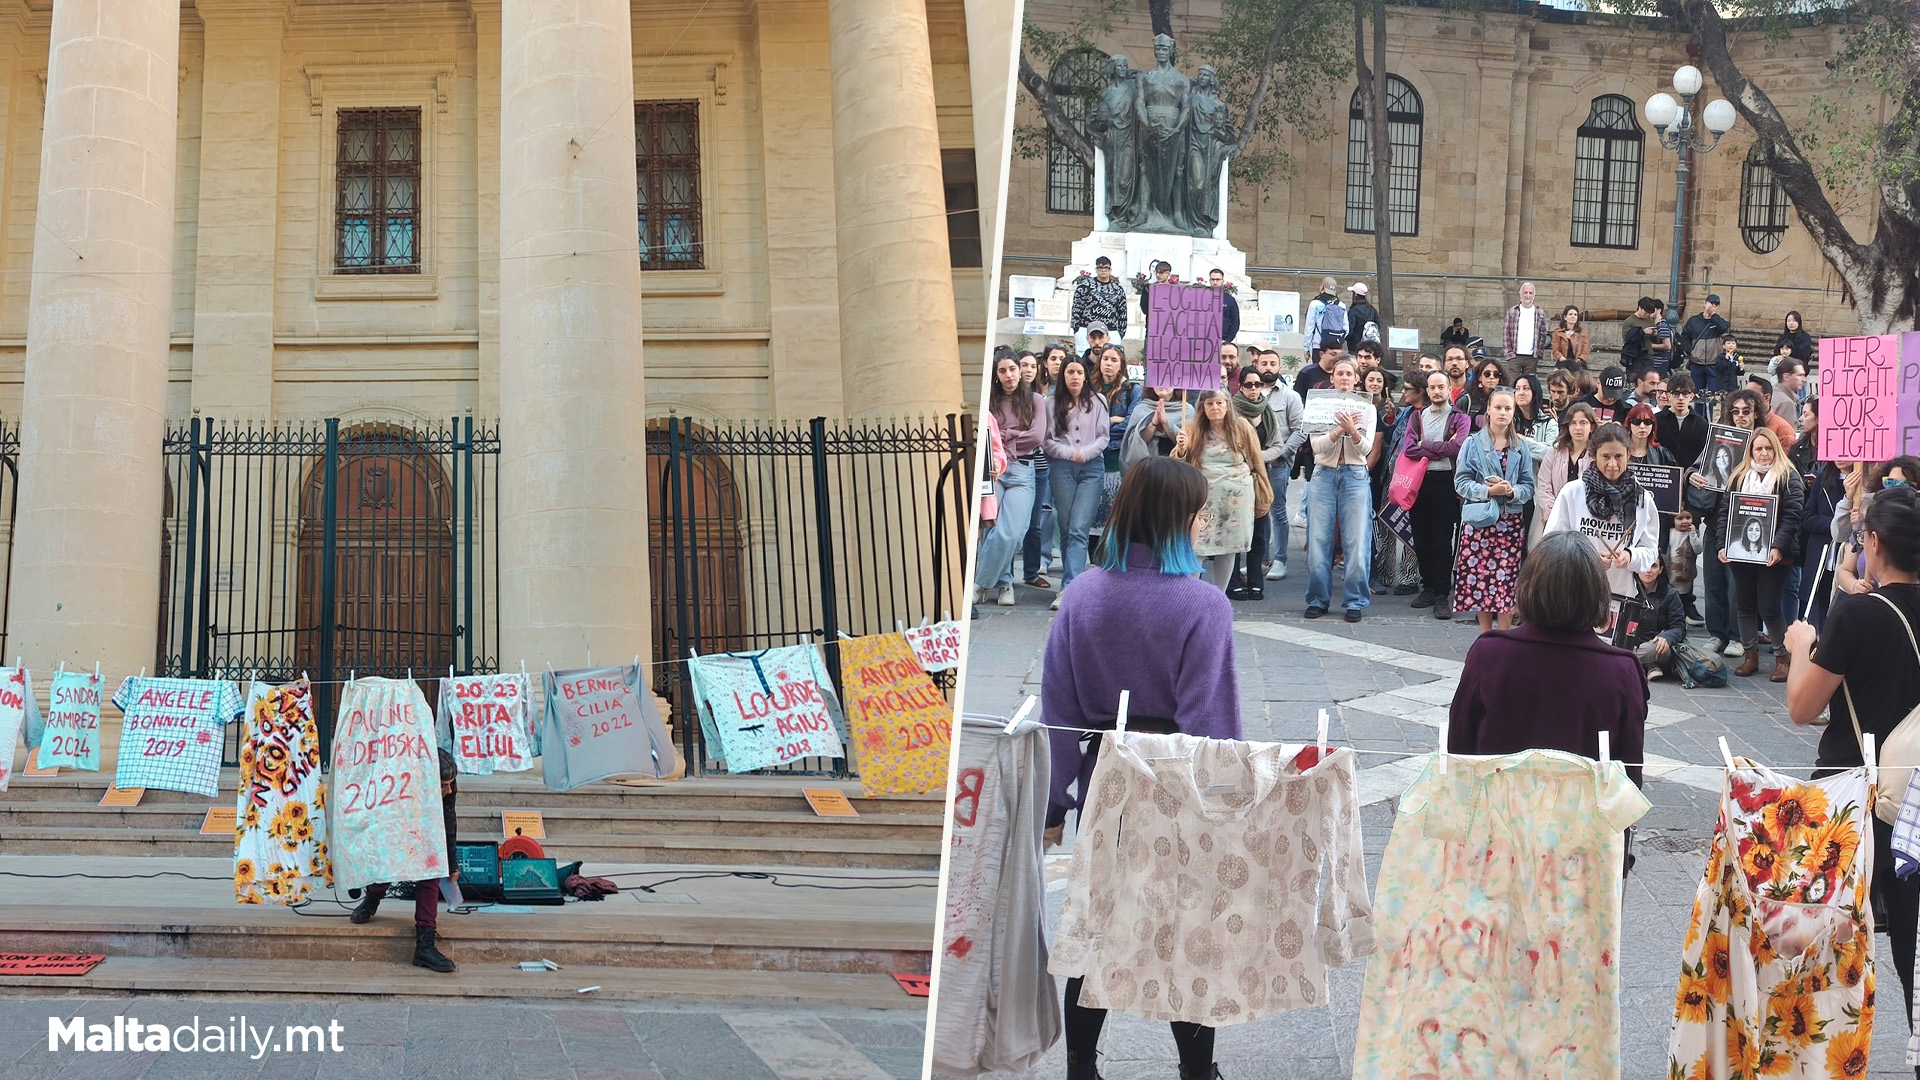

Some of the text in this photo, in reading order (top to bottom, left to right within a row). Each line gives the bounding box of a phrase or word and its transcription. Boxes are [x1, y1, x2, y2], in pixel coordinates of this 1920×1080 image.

[1832, 336, 1886, 368] HER
[1832, 397, 1885, 428] OUR
[1825, 426, 1890, 459] FIGHT
[921, 635, 961, 651] CAROL
[0, 688, 24, 710] ON
[55, 686, 100, 707] SANDRA
[137, 688, 215, 711] ANGELE
[576, 698, 624, 718] CILIA
[732, 679, 828, 721] LOURDES
[47, 710, 98, 730] RAMIREZ
[130, 714, 197, 731] BONNICI
[461, 702, 512, 730] RITA
[591, 713, 633, 738] 2022
[776, 711, 829, 738] AGIUS
[143, 737, 187, 758] 2019
[353, 732, 433, 767] DEMBSKA
[461, 733, 523, 760] ELLUL
[776, 738, 812, 761] 2018
[343, 771, 414, 815] 2022
